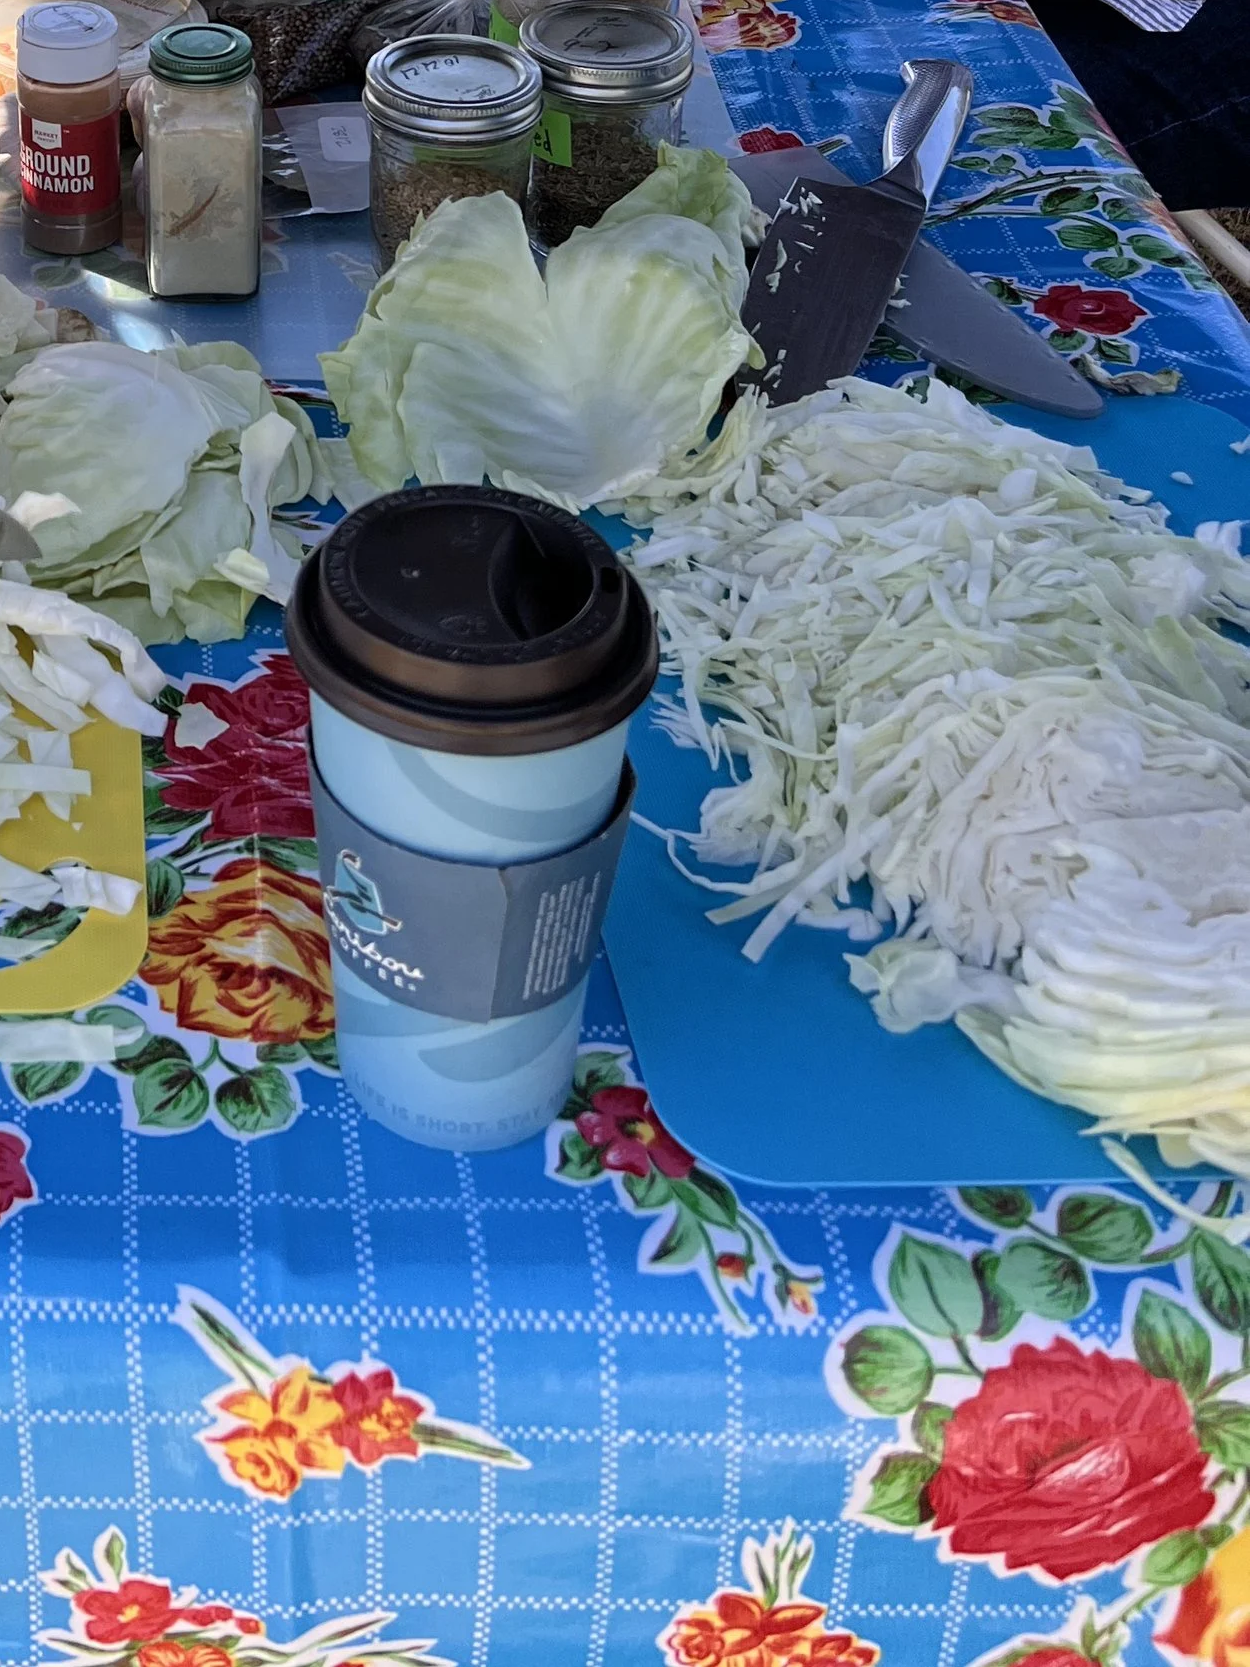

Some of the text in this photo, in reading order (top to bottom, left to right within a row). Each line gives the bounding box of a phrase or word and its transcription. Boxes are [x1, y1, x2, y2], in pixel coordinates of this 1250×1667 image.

[34, 130, 58, 140] MARKET
[20, 141, 91, 177] GROUND
[20, 161, 95, 194] CINNAMON
[322, 891, 425, 980] Caribou
